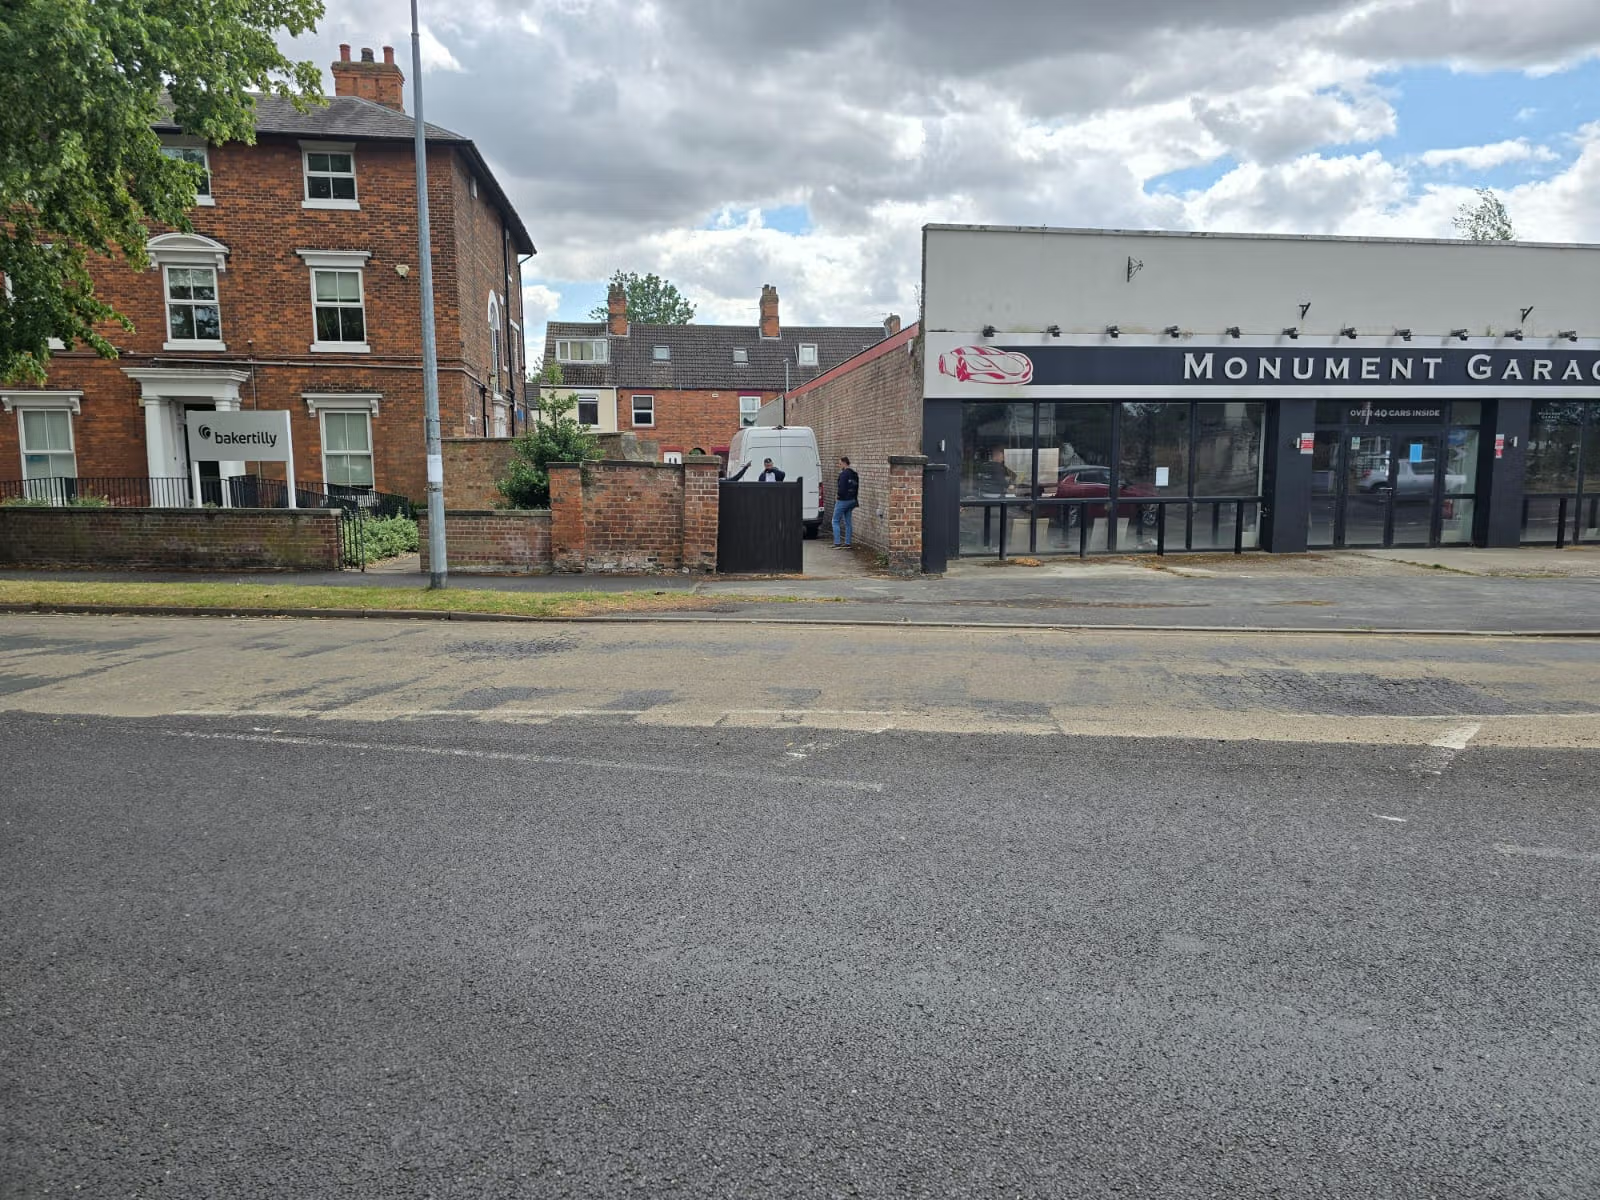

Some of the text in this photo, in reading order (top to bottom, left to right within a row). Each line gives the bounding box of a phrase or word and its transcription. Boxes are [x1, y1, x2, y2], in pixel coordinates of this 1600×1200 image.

[1183, 353, 1442, 380] MONUMENT
[1350, 408, 1440, 418] OVER 40 CARS INSIDE
[214, 431, 278, 448] bakertilly
